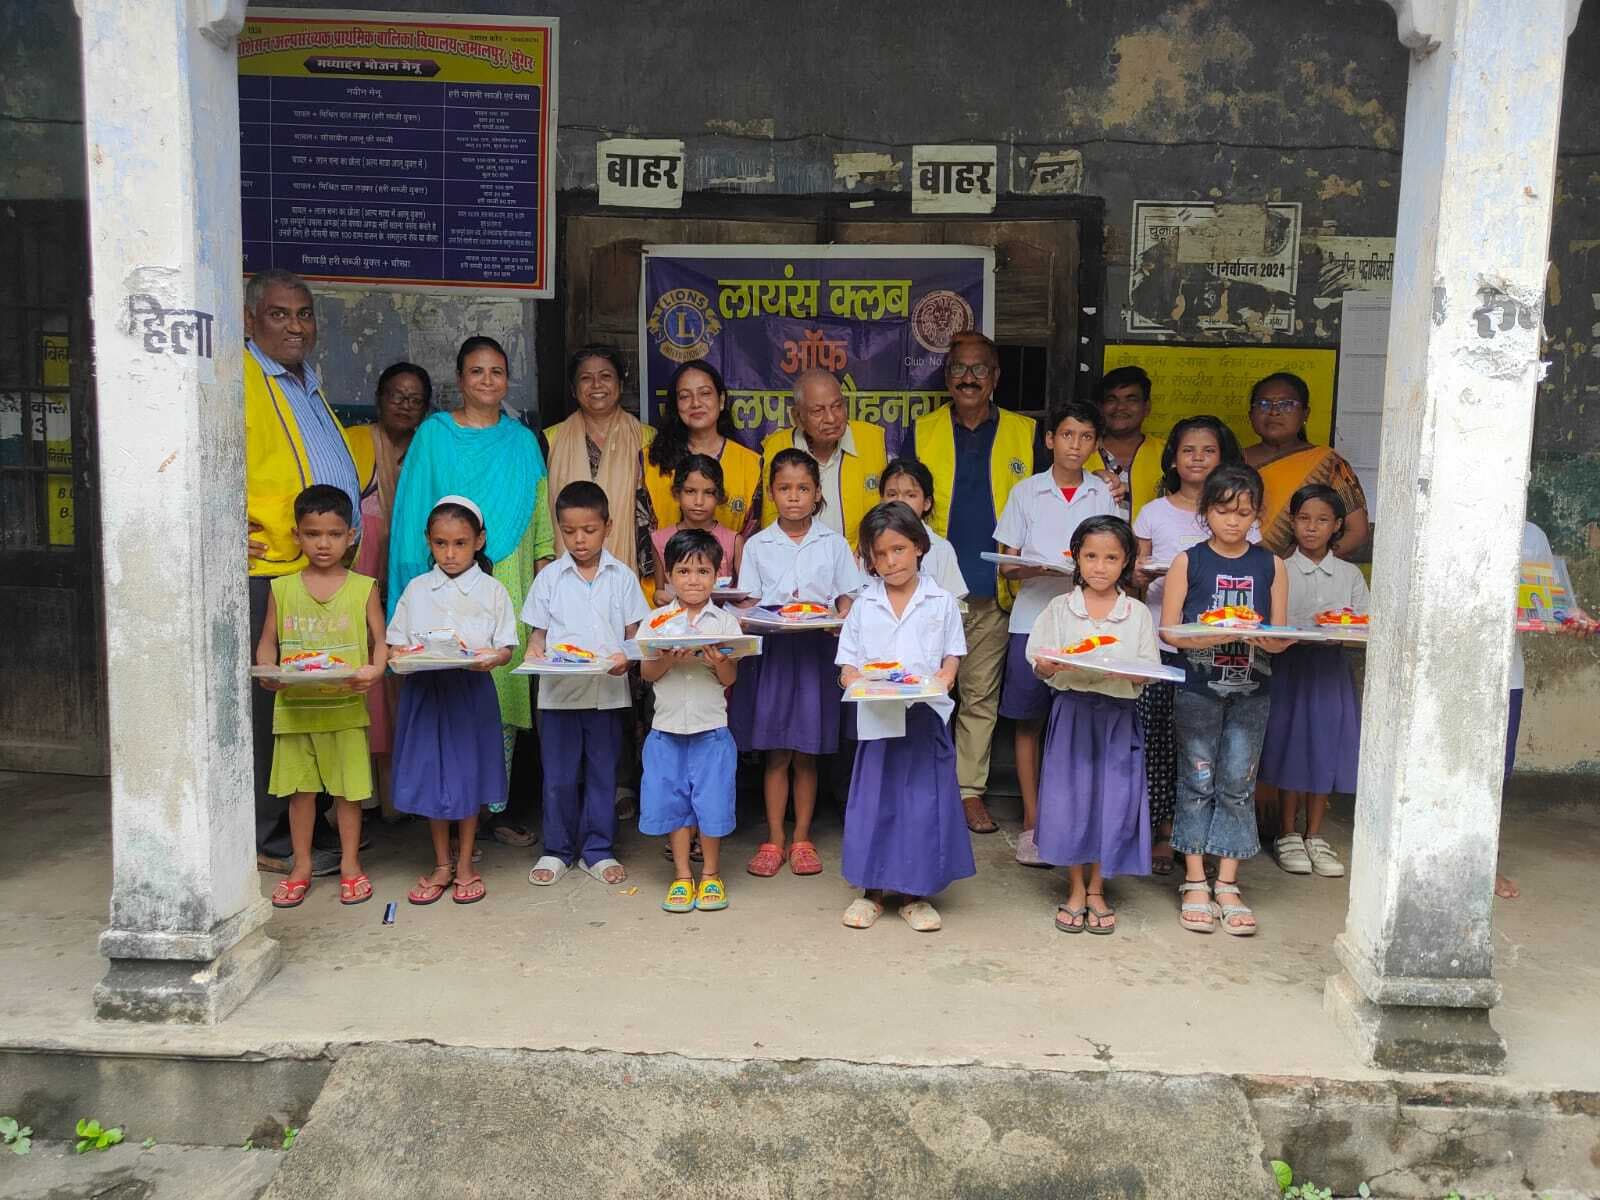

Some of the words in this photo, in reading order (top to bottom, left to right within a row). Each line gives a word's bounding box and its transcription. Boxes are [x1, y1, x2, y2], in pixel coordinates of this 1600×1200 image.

[332, 26, 374, 48] प्राथमिक
[375, 27, 415, 49] बालिका
[365, 59, 399, 71] भोजन
[402, 59, 422, 75] मेनू
[606, 153, 681, 189] बाहर
[918, 161, 995, 194] बाहर
[1216, 257, 1258, 277] निर्वाचन
[1260, 263, 1285, 278] 2024
[662, 290, 706, 308] LIONS
[718, 264, 820, 319] लायंस
[828, 279, 913, 320] क्लब
[675, 311, 696, 338] L
[780, 328, 848, 375] ऑफ
[904, 356, 925, 367] Club
